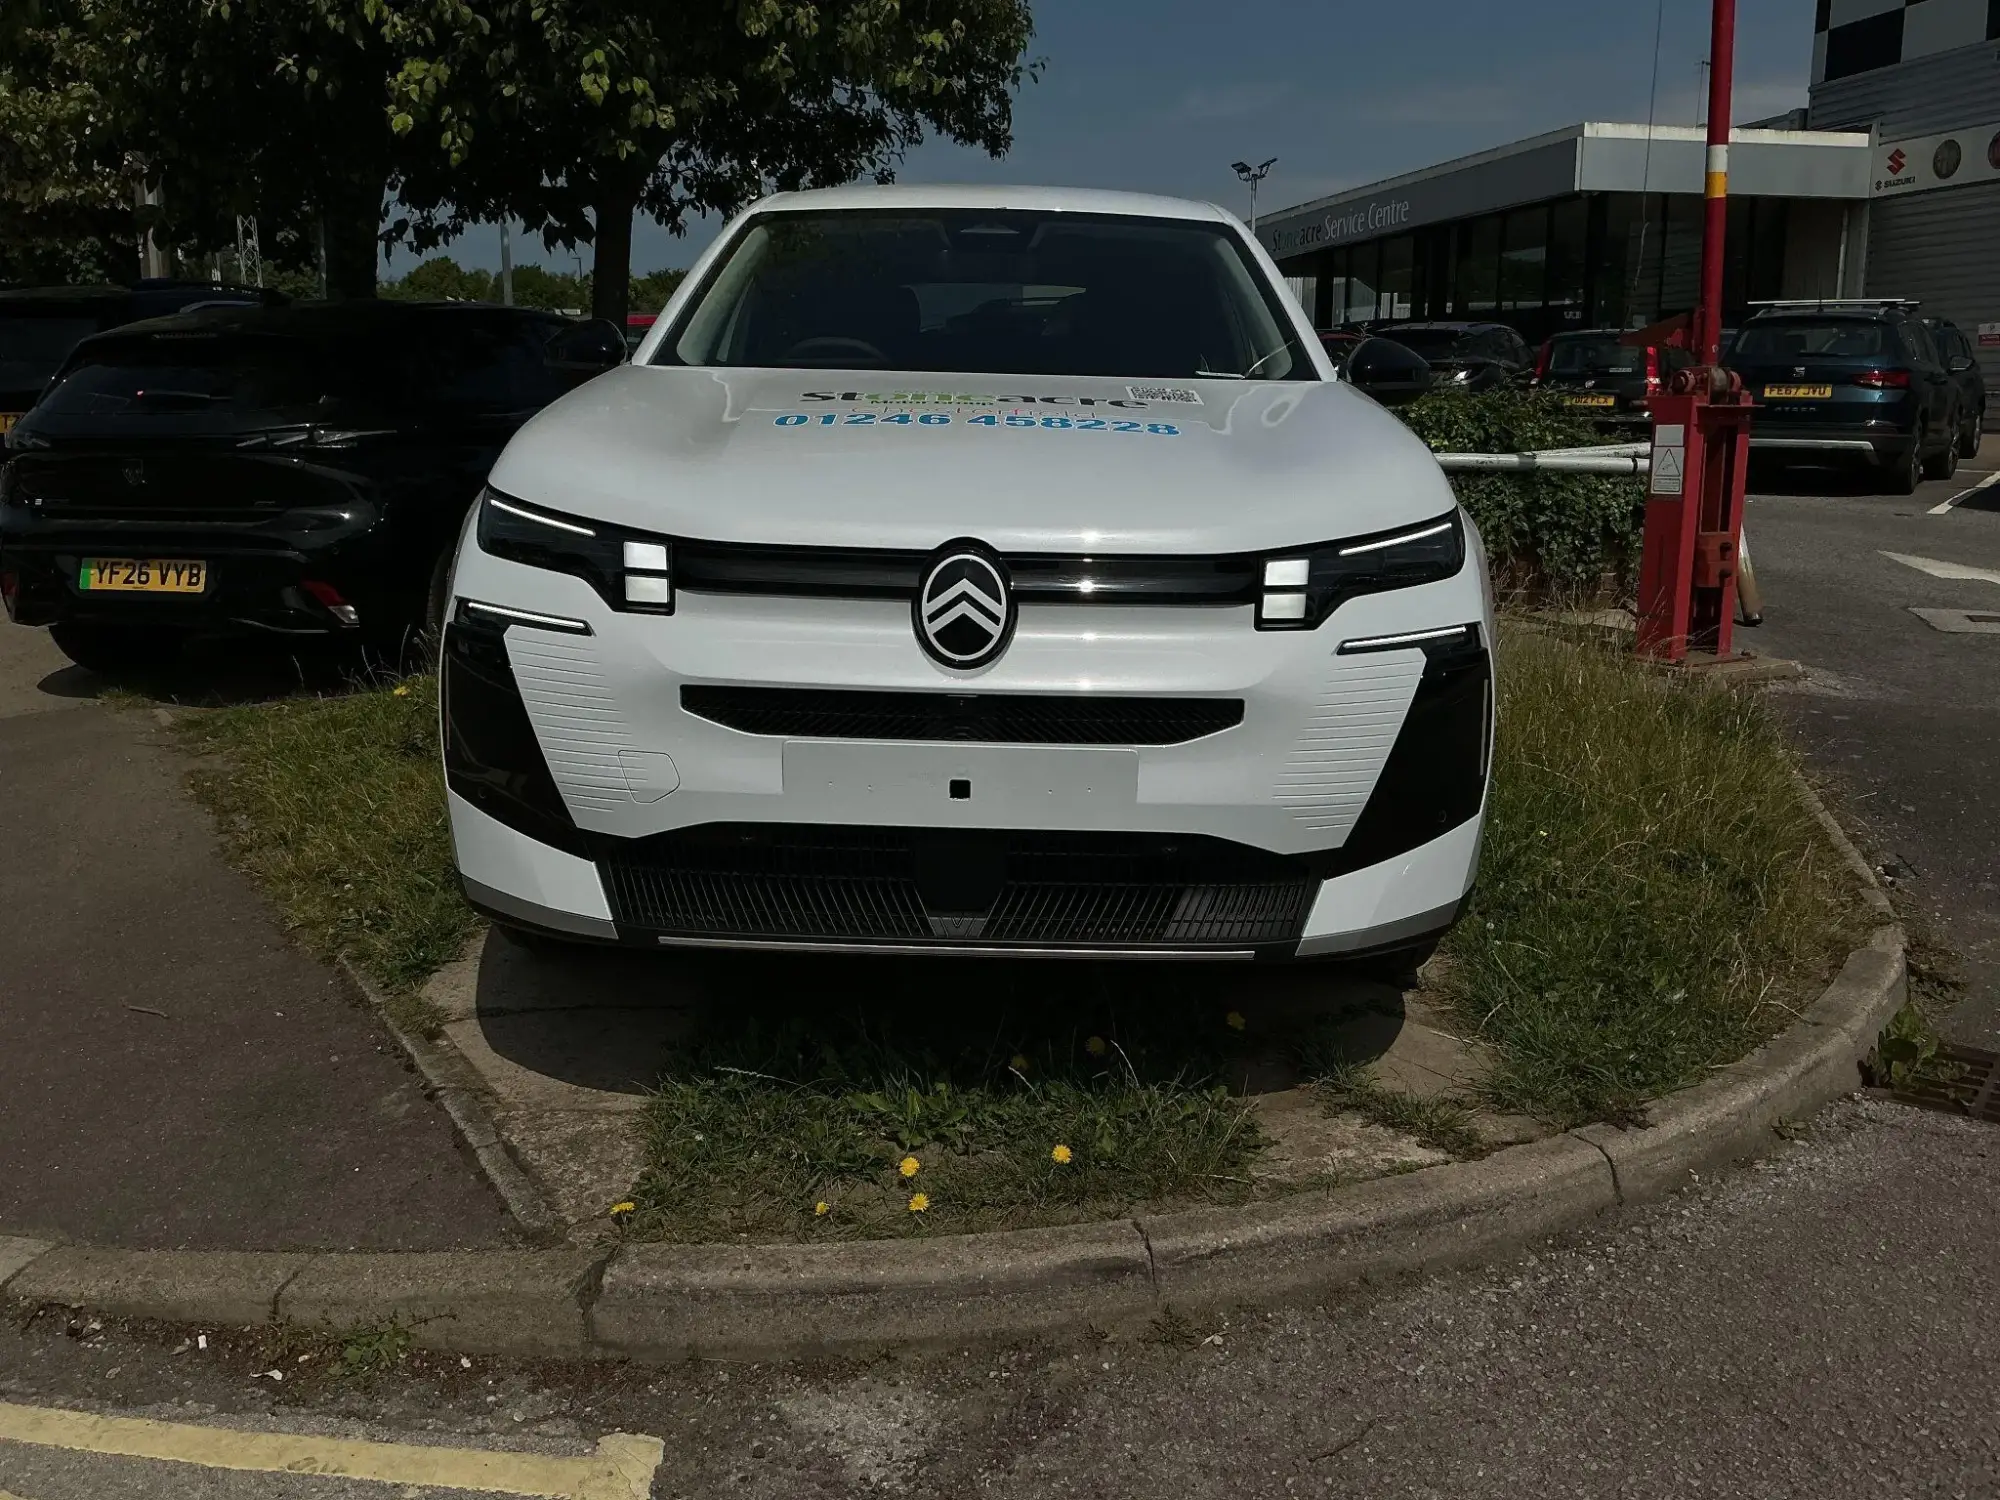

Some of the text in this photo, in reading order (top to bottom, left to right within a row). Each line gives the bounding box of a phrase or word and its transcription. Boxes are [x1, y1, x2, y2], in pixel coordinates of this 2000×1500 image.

[1883, 176, 1916, 188] SUZUKI
[1272, 199, 1410, 252] Stoneacre Service Centre
[799, 390, 1150, 411] stoneacre
[773, 412, 1182, 437] 01246 458228
[96, 560, 202, 587] YF26 VYB
